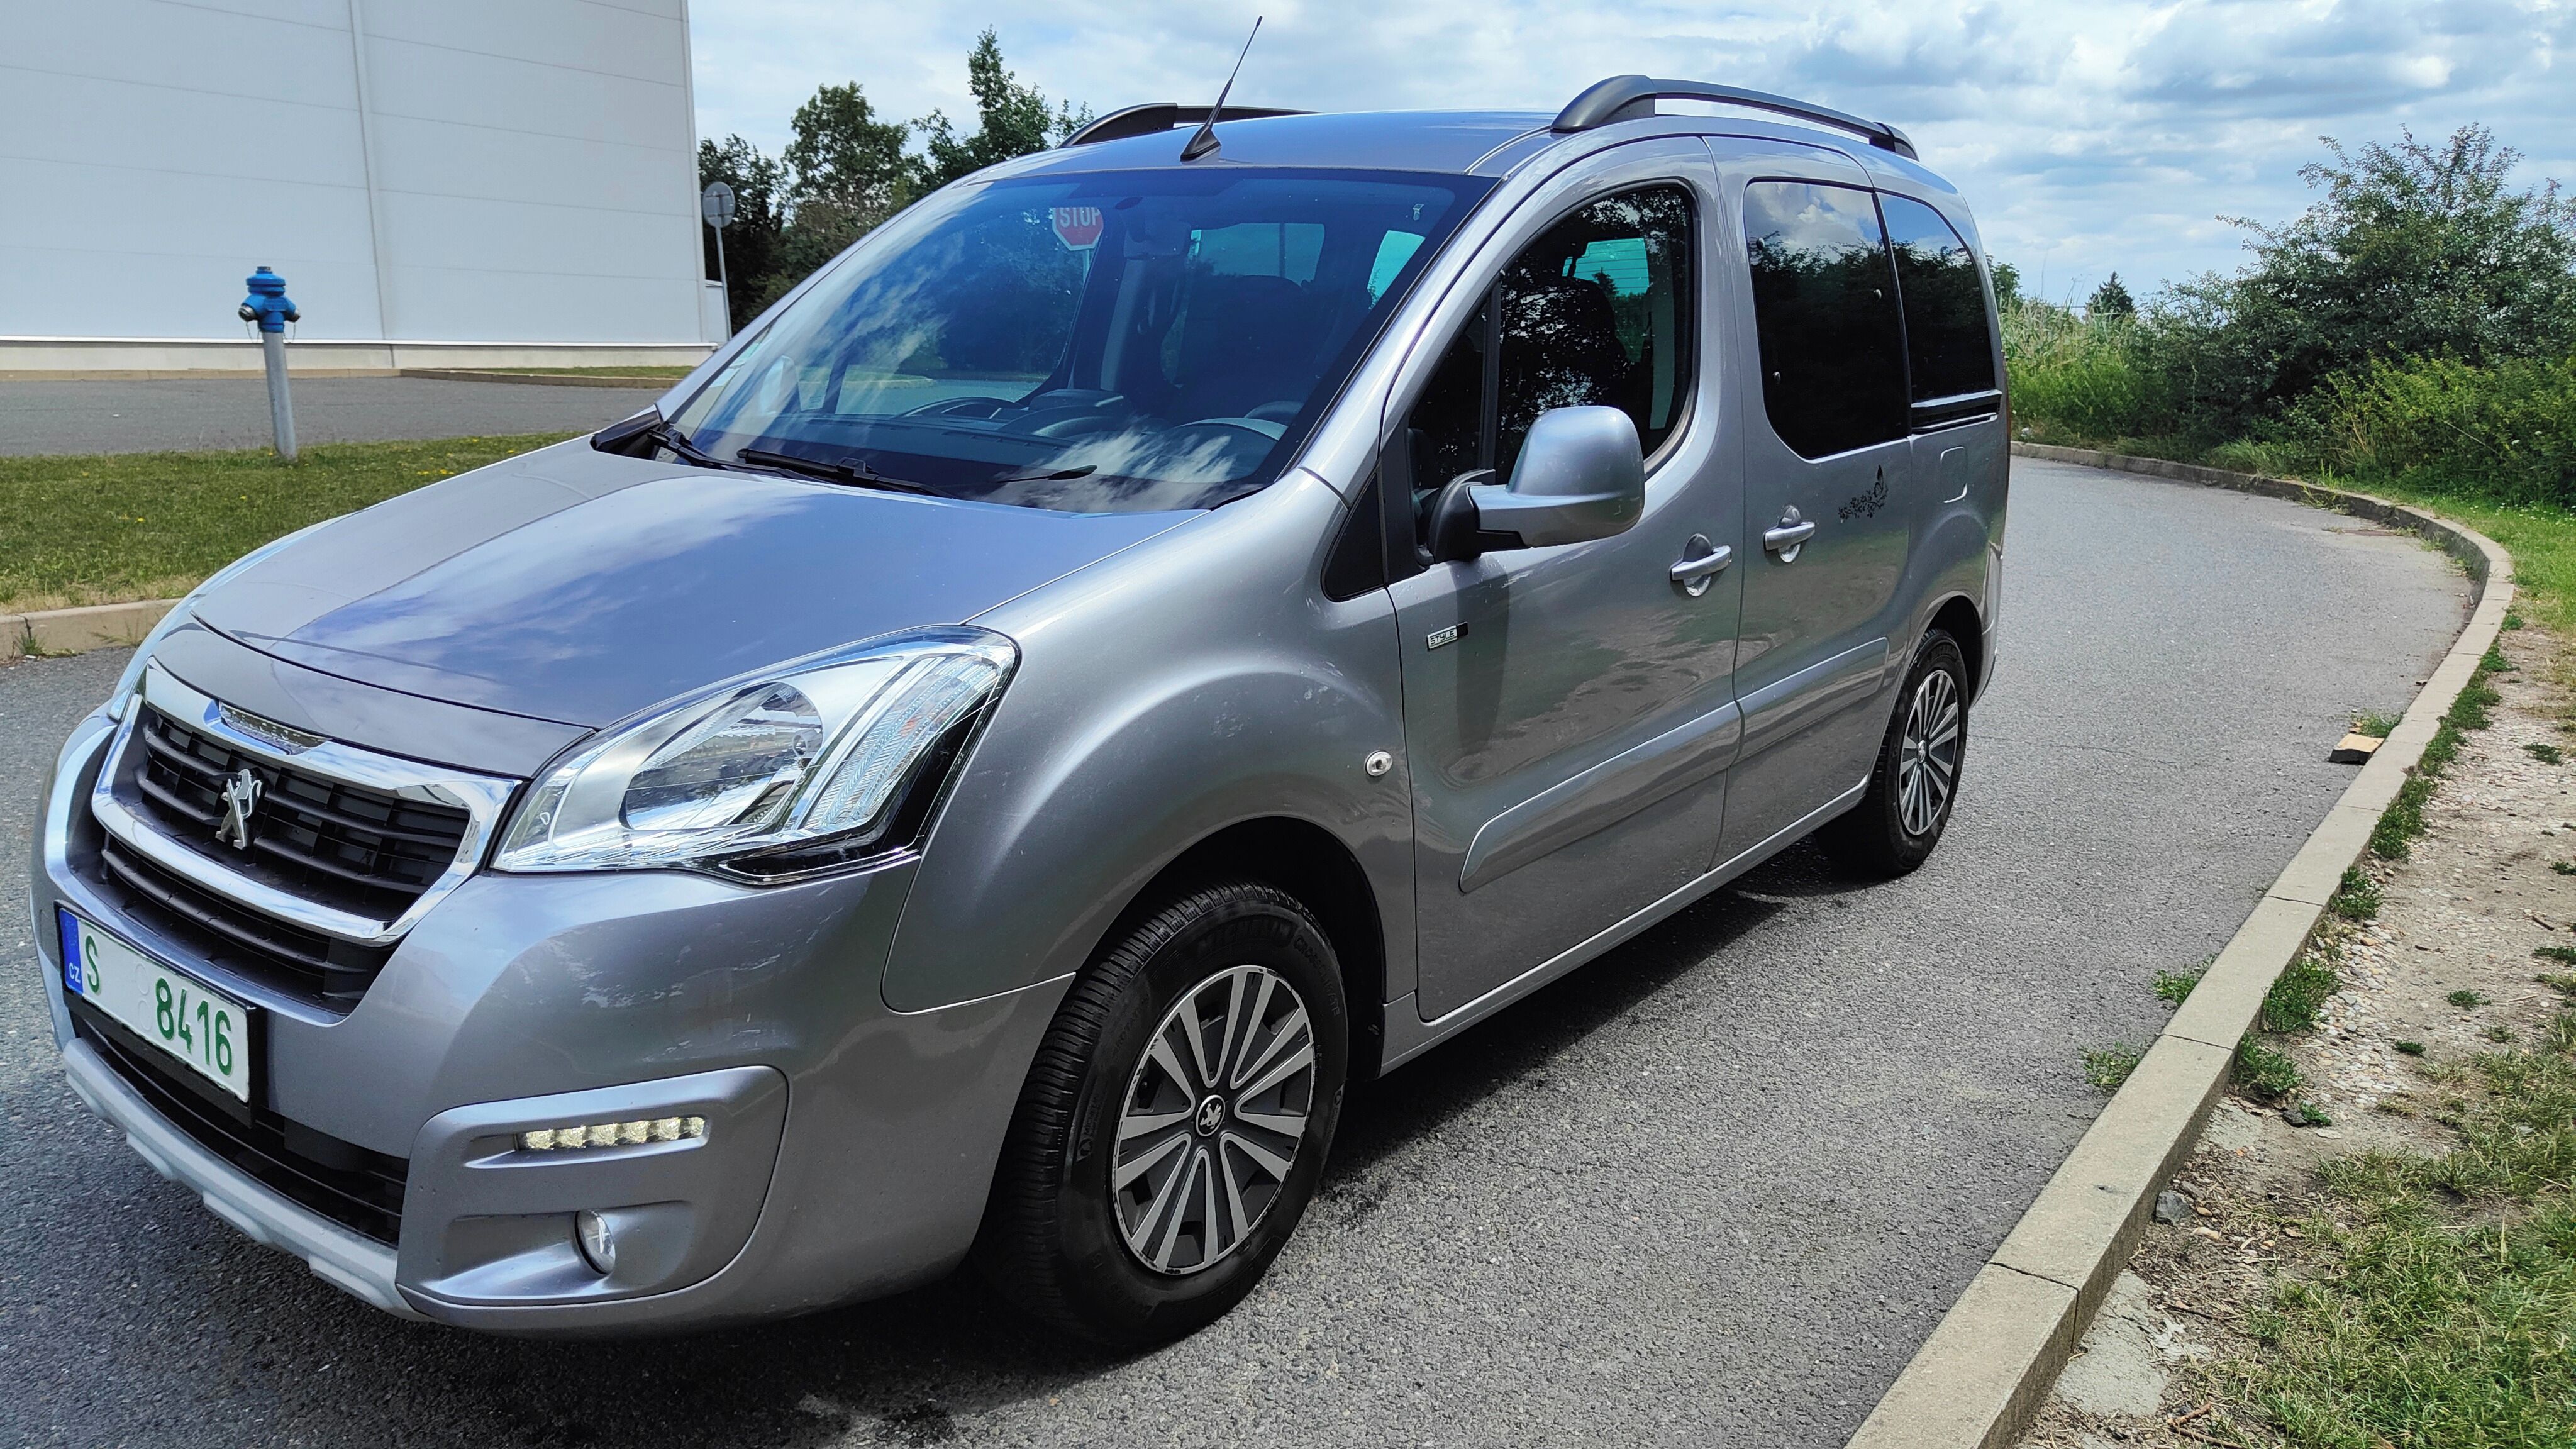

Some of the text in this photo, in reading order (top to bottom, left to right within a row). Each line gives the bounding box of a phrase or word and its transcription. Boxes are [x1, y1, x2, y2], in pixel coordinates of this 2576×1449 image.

[1059, 207, 1101, 227] STOP
[1430, 630, 1455, 645] STYLE
[69, 962, 81, 984] CZ
[85, 935, 233, 1077] S 8416
